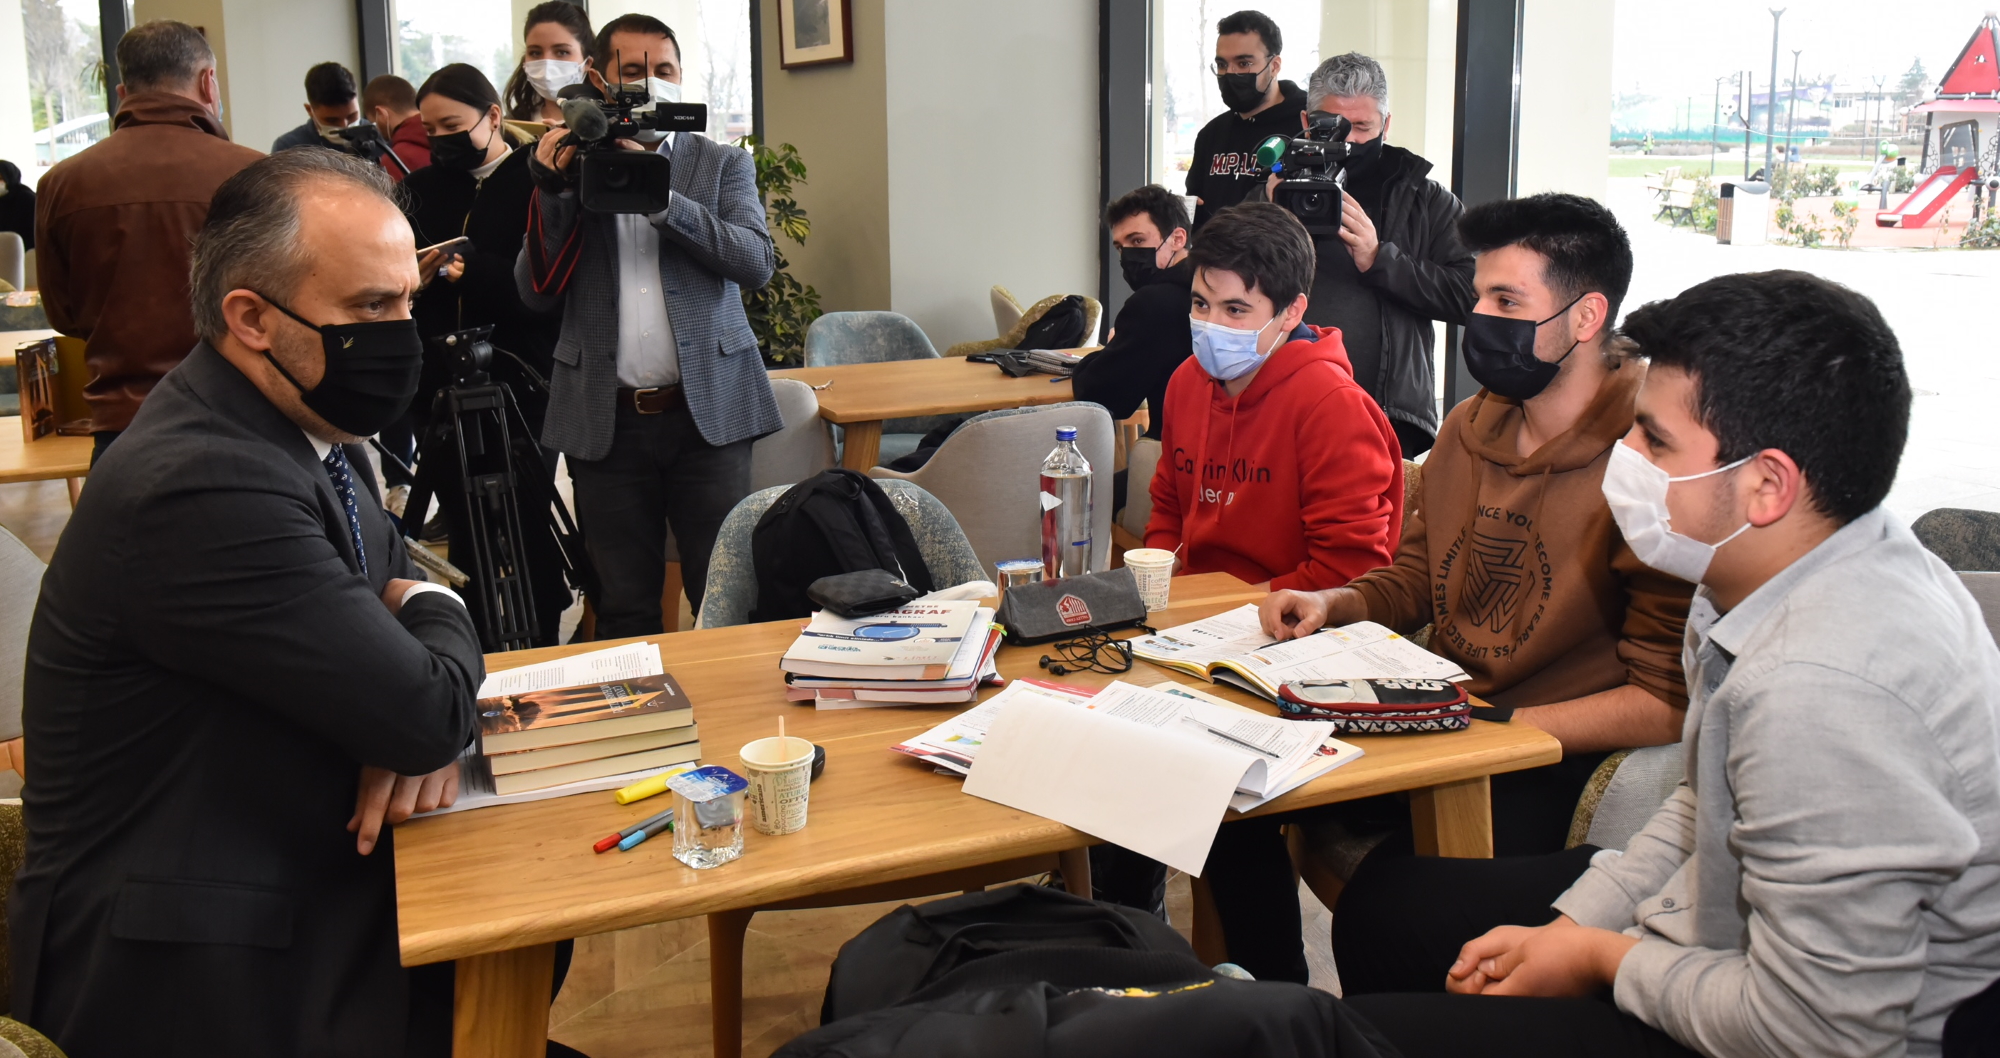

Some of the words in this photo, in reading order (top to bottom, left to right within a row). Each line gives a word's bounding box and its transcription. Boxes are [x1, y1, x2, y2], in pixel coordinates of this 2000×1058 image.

[1477, 505, 1501, 519] NCE
[1464, 642, 1489, 659] LIFE
[757, 783, 767, 823] americano
